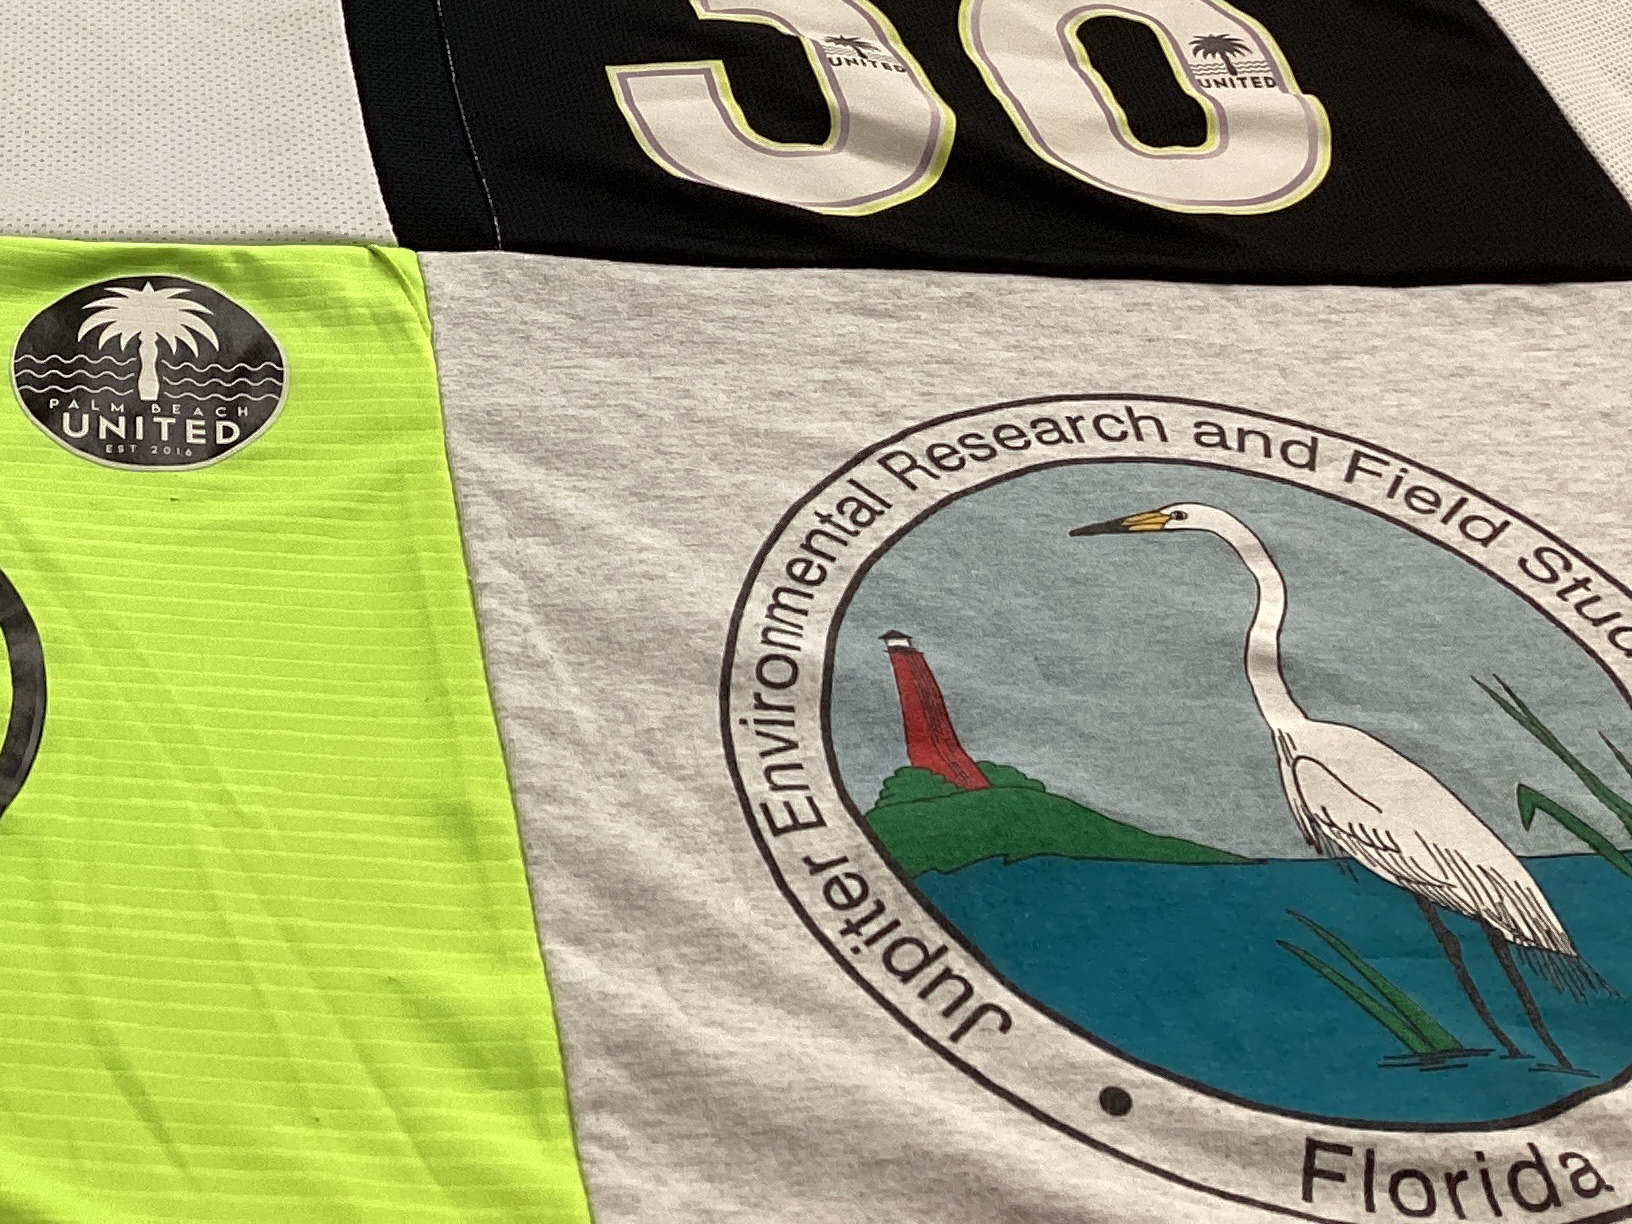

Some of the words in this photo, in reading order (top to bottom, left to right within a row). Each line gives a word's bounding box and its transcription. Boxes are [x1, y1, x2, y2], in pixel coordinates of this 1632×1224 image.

[828, 55, 907, 74] UNITED
[1196, 74, 1278, 91] UNITED
[49, 398, 126, 414] PALM
[150, 402, 249, 418] BEACH
[61, 412, 242, 445] UNITED
[105, 444, 138, 454] EST
[150, 445, 194, 458] 2016
[877, 405, 1169, 492] Research
[1193, 415, 1319, 473] and
[1343, 449, 1513, 549] Field
[739, 477, 893, 838] Environmental
[802, 854, 1013, 1045] Jupiter
[1301, 1136, 1615, 1220] Florida
